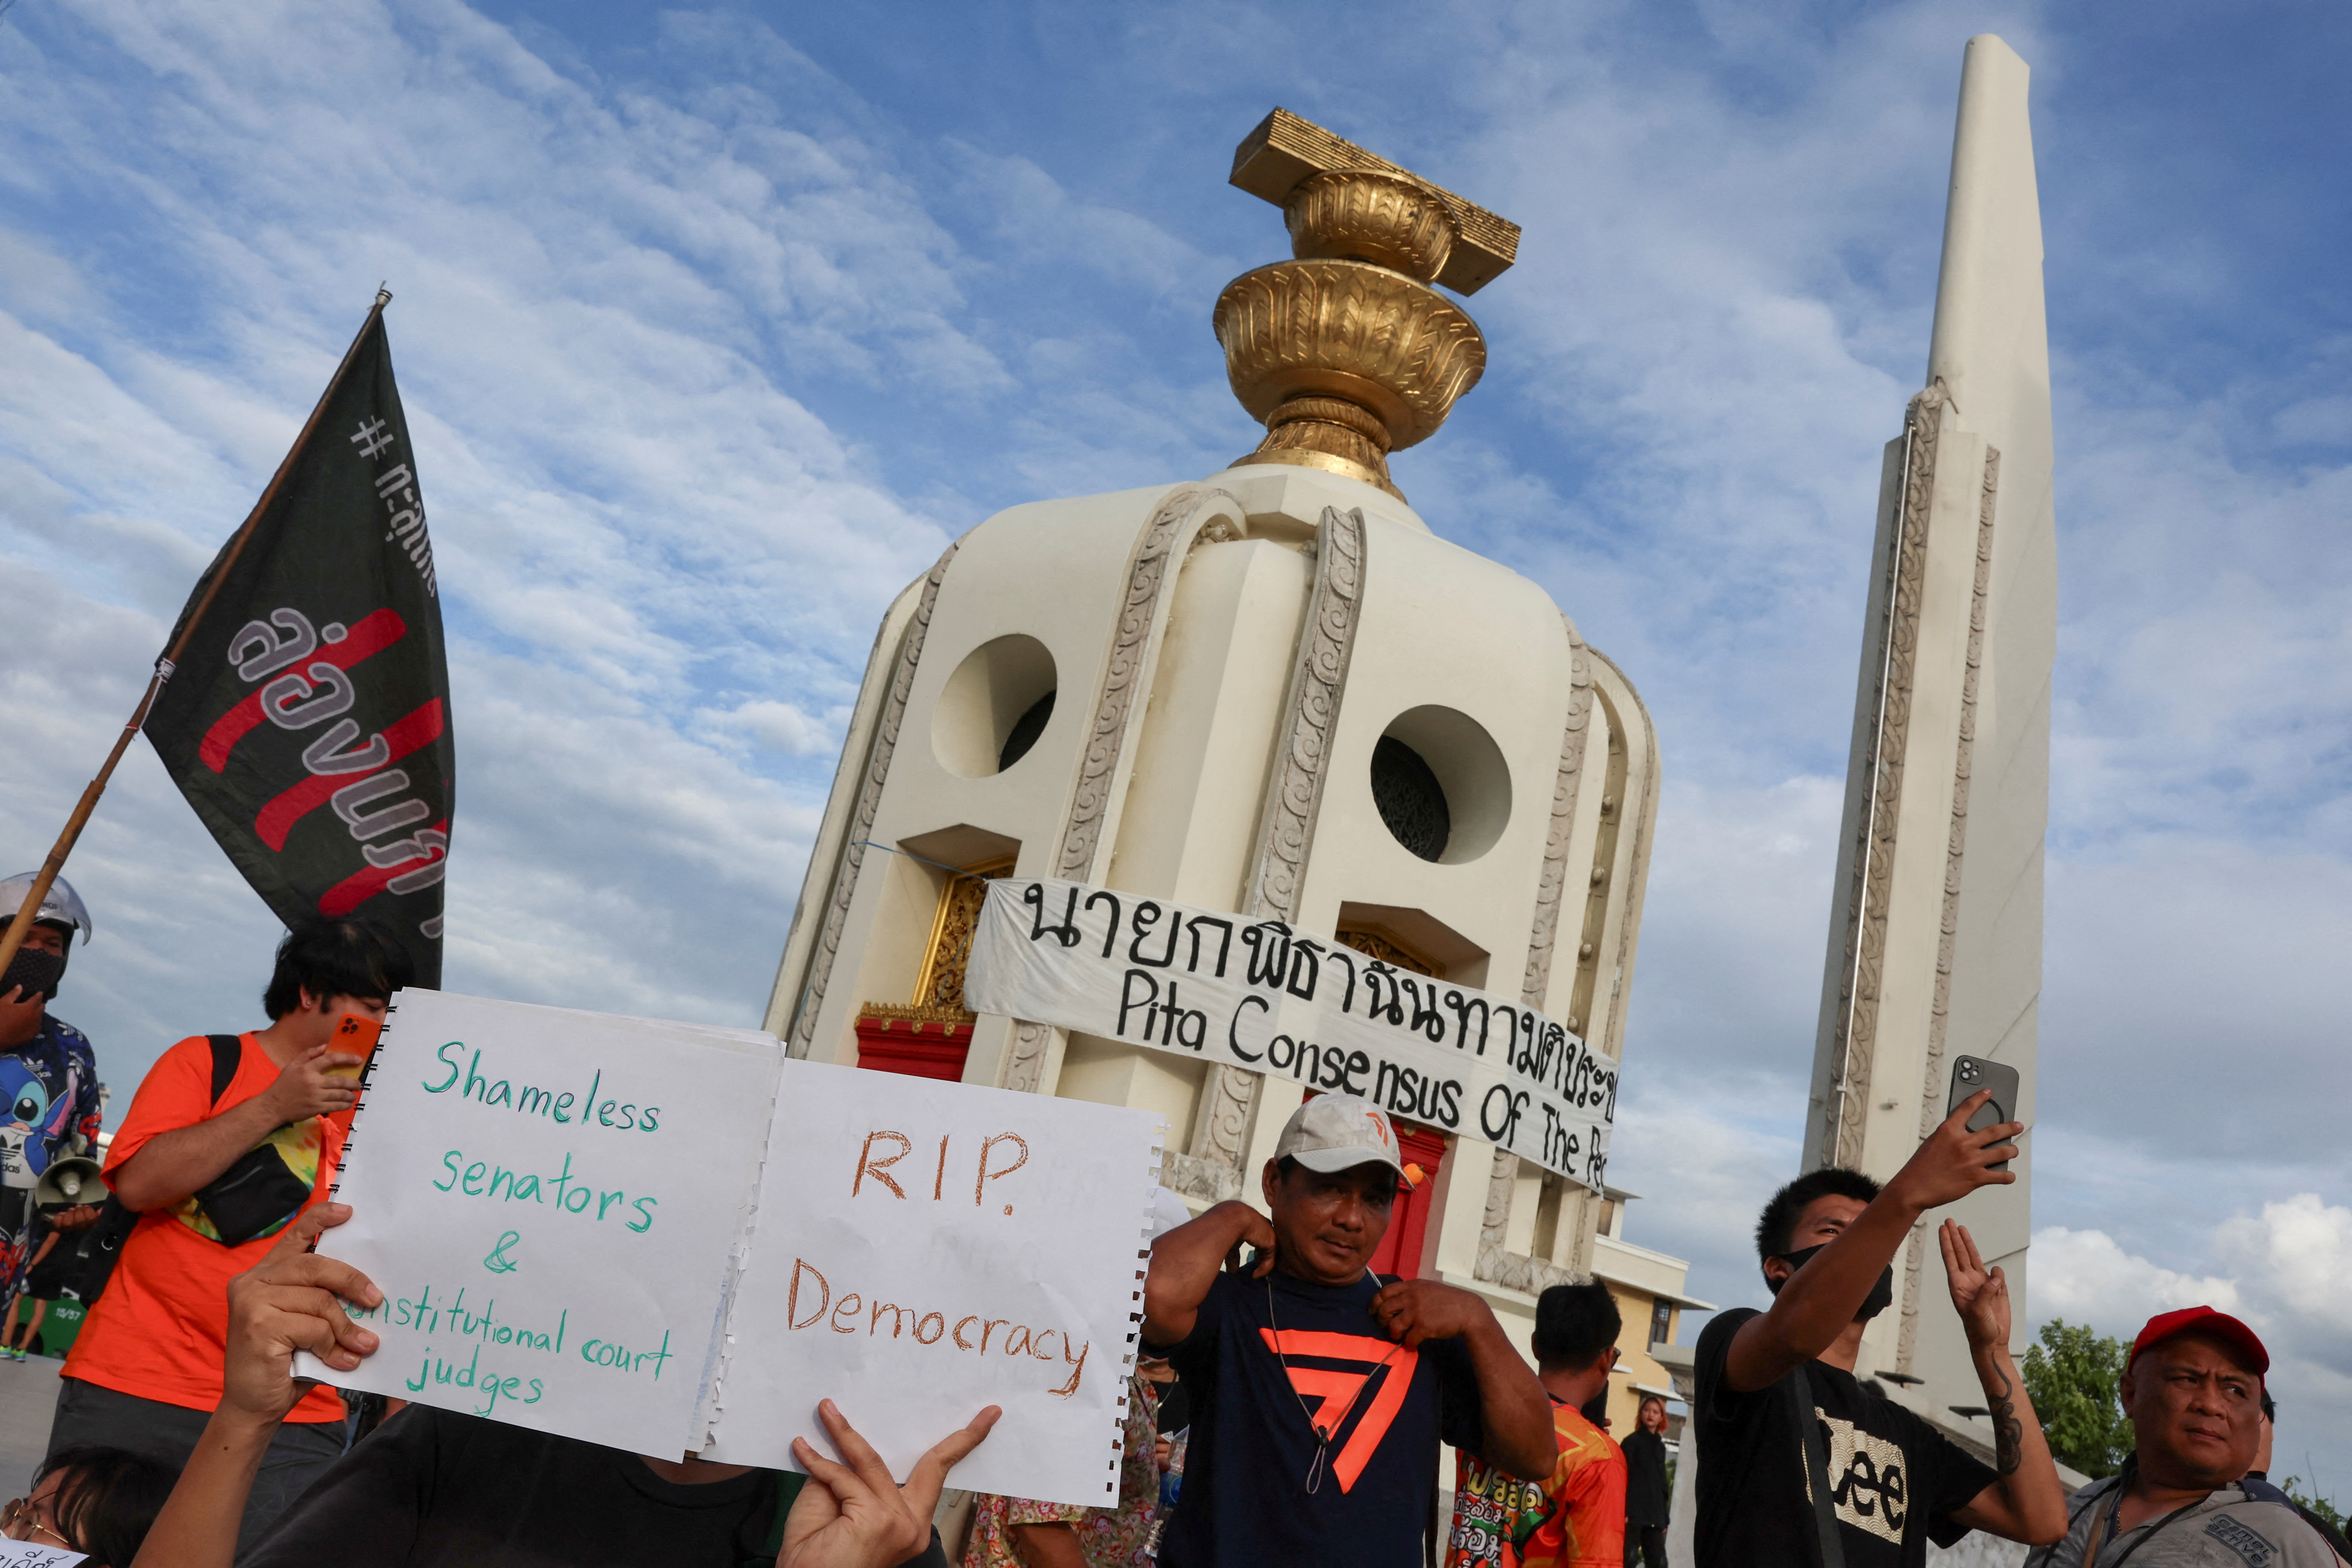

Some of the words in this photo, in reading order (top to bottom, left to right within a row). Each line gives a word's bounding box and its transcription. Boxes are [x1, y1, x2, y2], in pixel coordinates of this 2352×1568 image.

[421, 1041, 662, 1132] Shameless
[1117, 969, 1207, 1051] Pita
[1229, 995, 1463, 1128] Consensus
[1480, 1084, 1530, 1149] Of
[1542, 1102, 1580, 1174] The
[483, 1230, 521, 1274] &
[334, 1285, 568, 1354] onstitutional
[580, 1329, 674, 1381] court
[788, 1258, 1089, 1400] Democracy
[404, 1344, 545, 1418] judges
